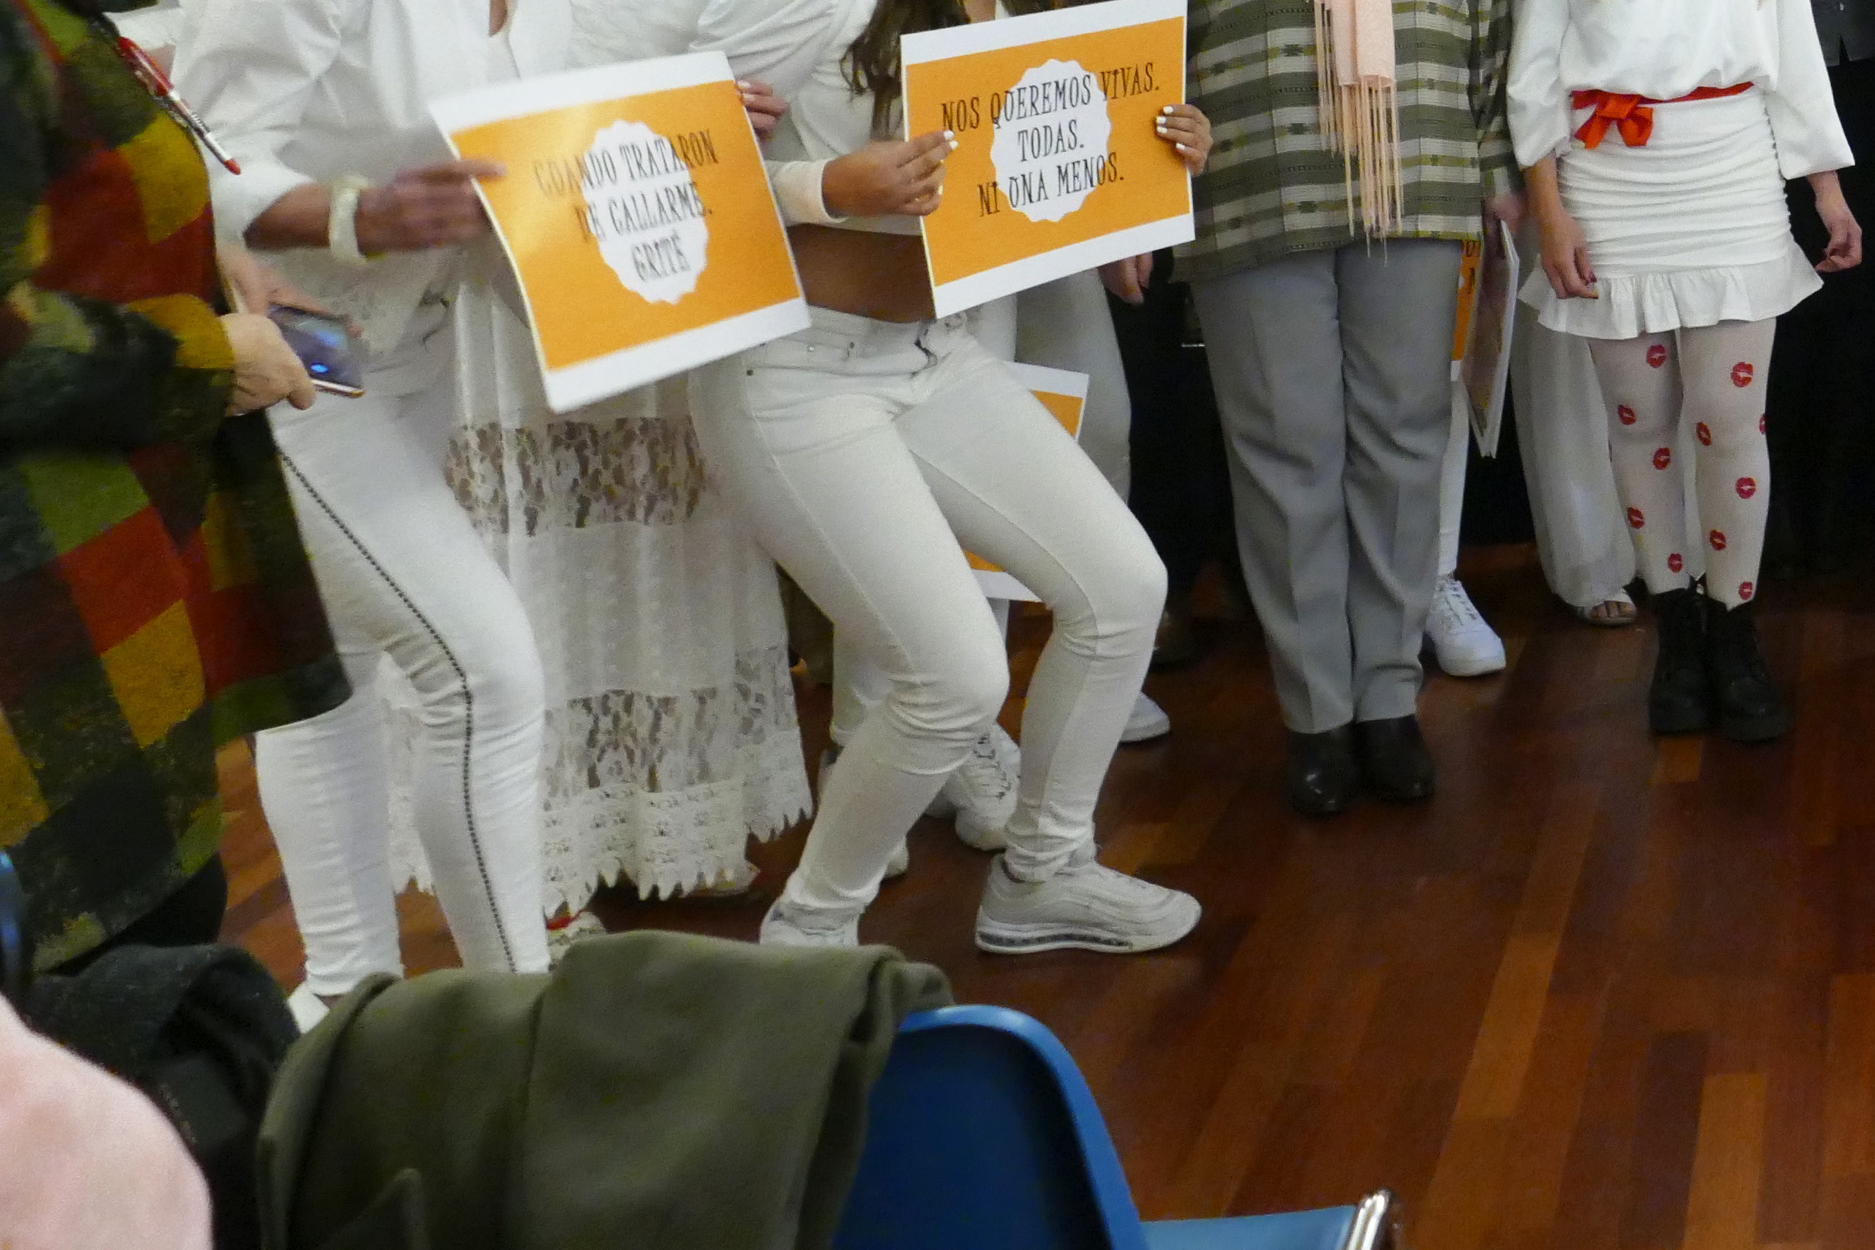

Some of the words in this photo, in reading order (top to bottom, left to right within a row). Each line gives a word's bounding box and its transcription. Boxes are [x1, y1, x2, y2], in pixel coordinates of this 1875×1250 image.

[941, 97, 980, 133] NOS
[990, 75, 1091, 129] QUEREMOS
[1100, 62, 1160, 102] VIVAS.
[532, 147, 617, 197] CUANDO
[619, 129, 719, 181] TRATARON
[1017, 119, 1084, 163] TODAS.
[977, 181, 1001, 218] NI
[1009, 169, 1049, 208] UNA
[1057, 152, 1124, 197] MENOS.
[574, 201, 606, 243] DE
